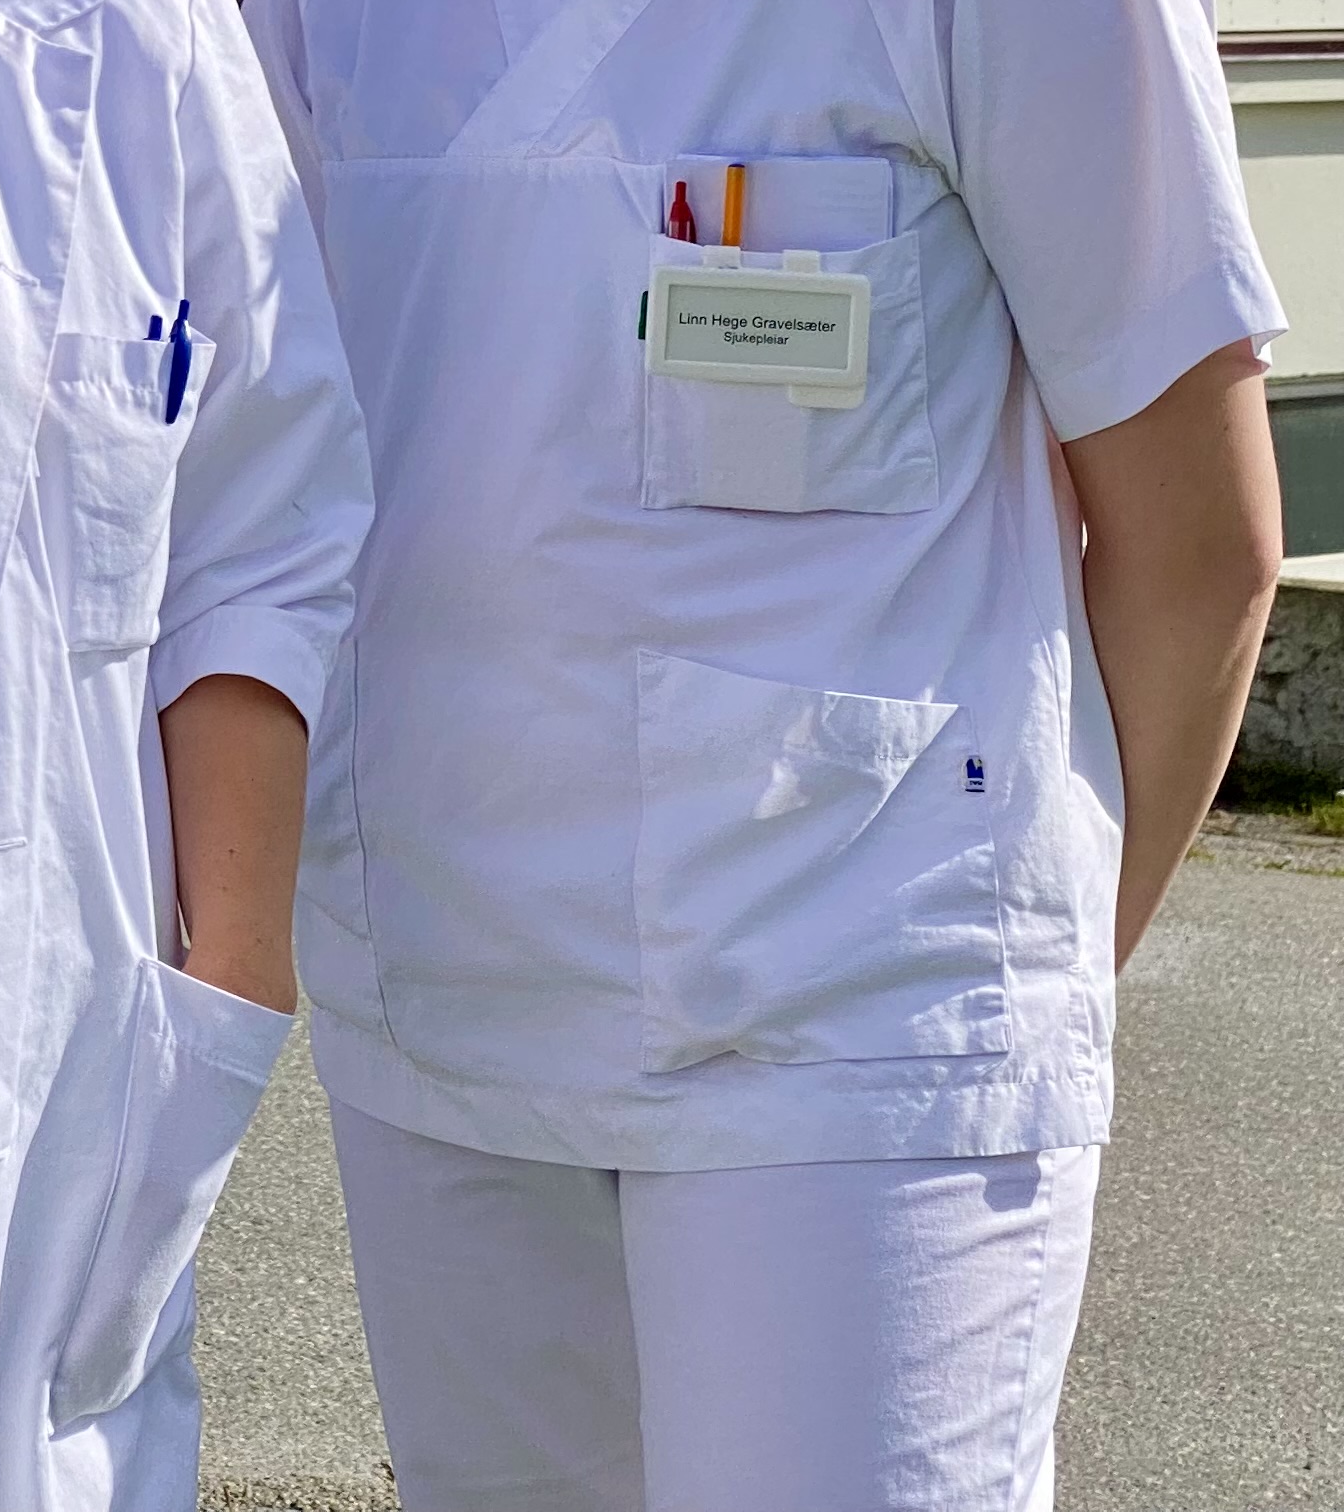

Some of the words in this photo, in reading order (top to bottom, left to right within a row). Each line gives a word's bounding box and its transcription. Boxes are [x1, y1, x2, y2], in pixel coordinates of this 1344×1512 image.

[678, 312, 707, 326] Linn
[711, 314, 748, 330] Hege
[751, 316, 837, 333] Gravelsæter
[723, 331, 789, 346] Sjukepleiar
